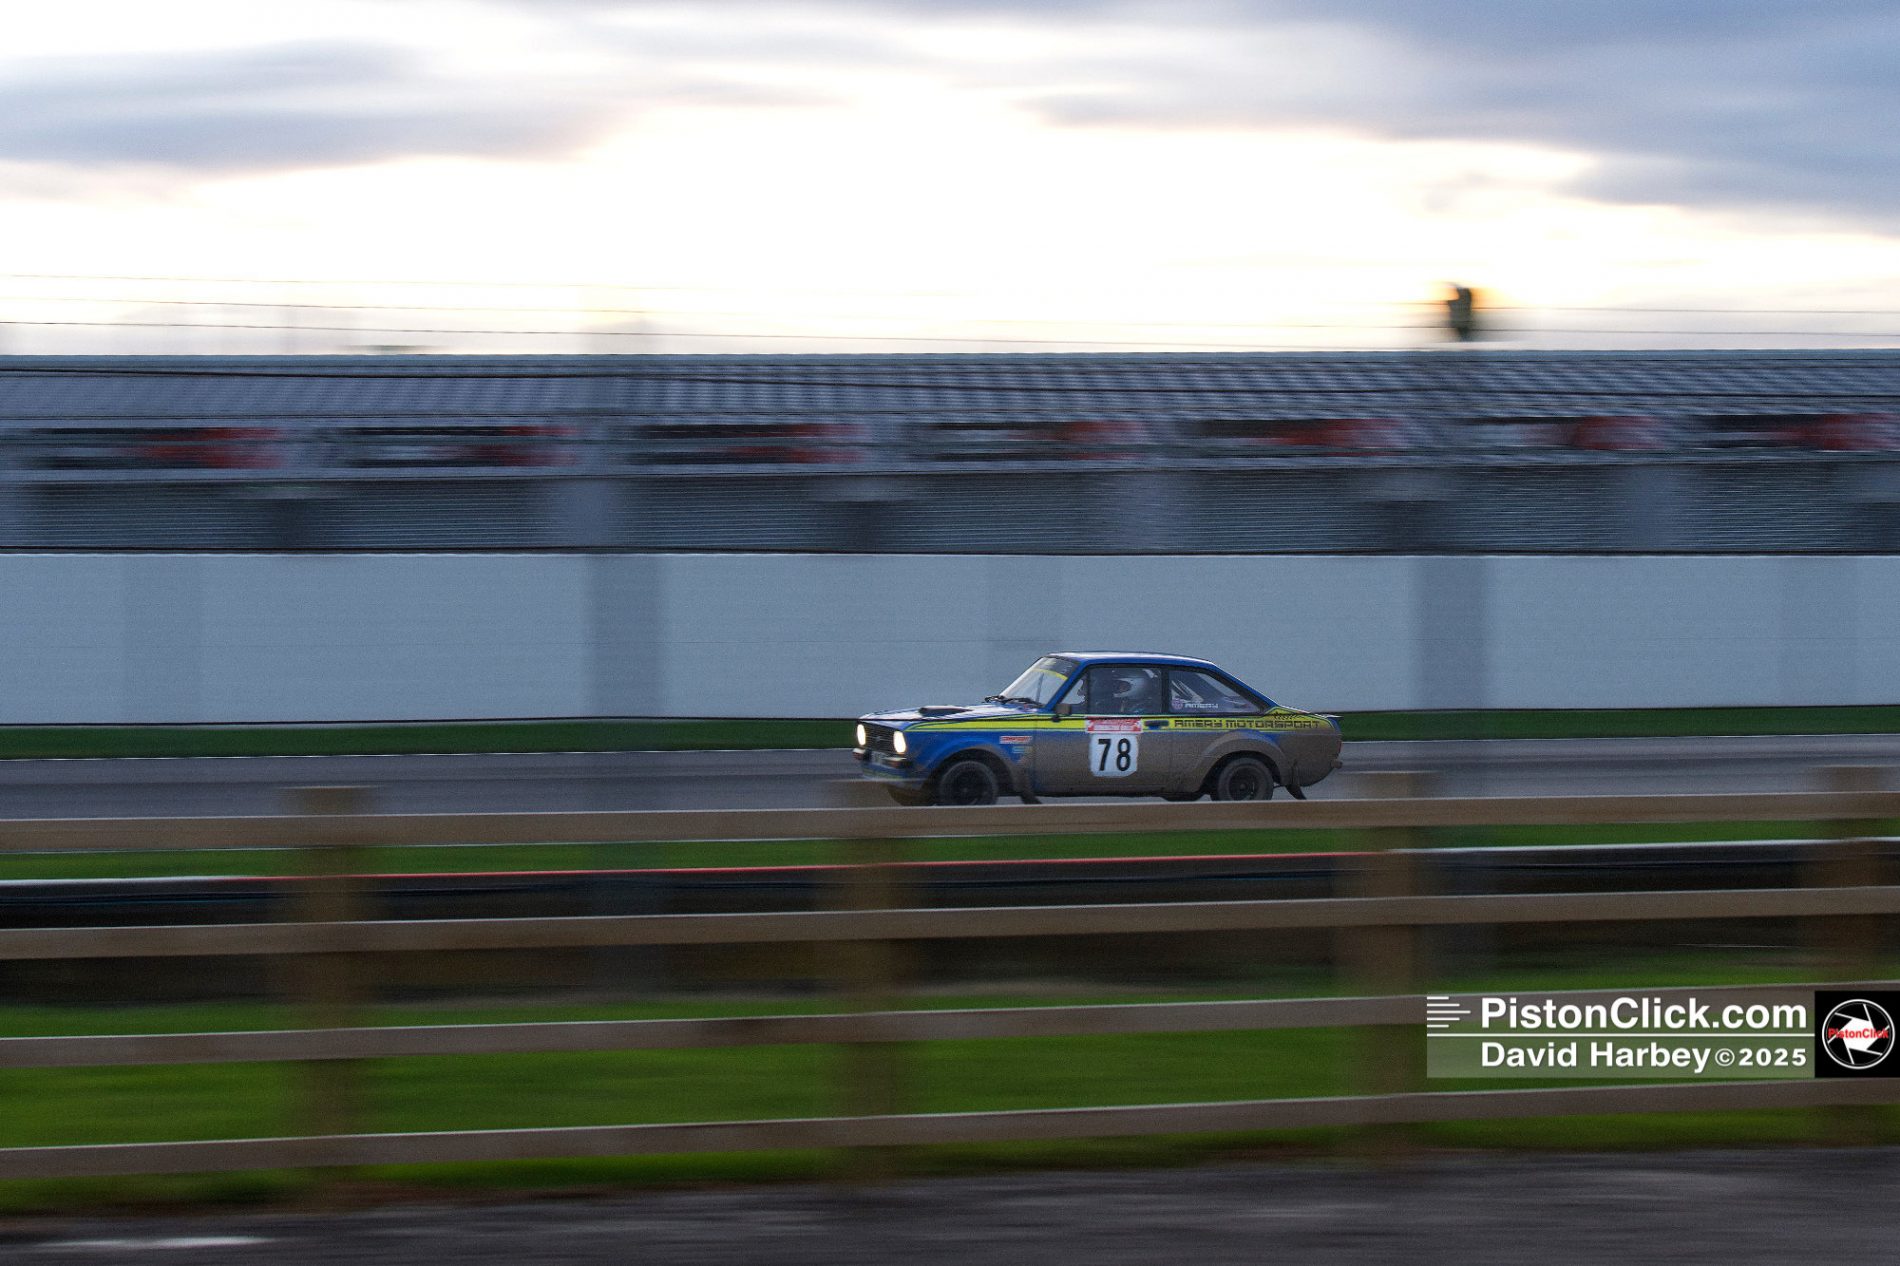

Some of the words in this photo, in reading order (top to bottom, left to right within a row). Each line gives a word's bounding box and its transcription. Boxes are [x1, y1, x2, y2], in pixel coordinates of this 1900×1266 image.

[1174, 720, 1223, 729] AMERY
[1226, 720, 1320, 729] MOTORSPORT
[1098, 738, 1131, 771] 78
